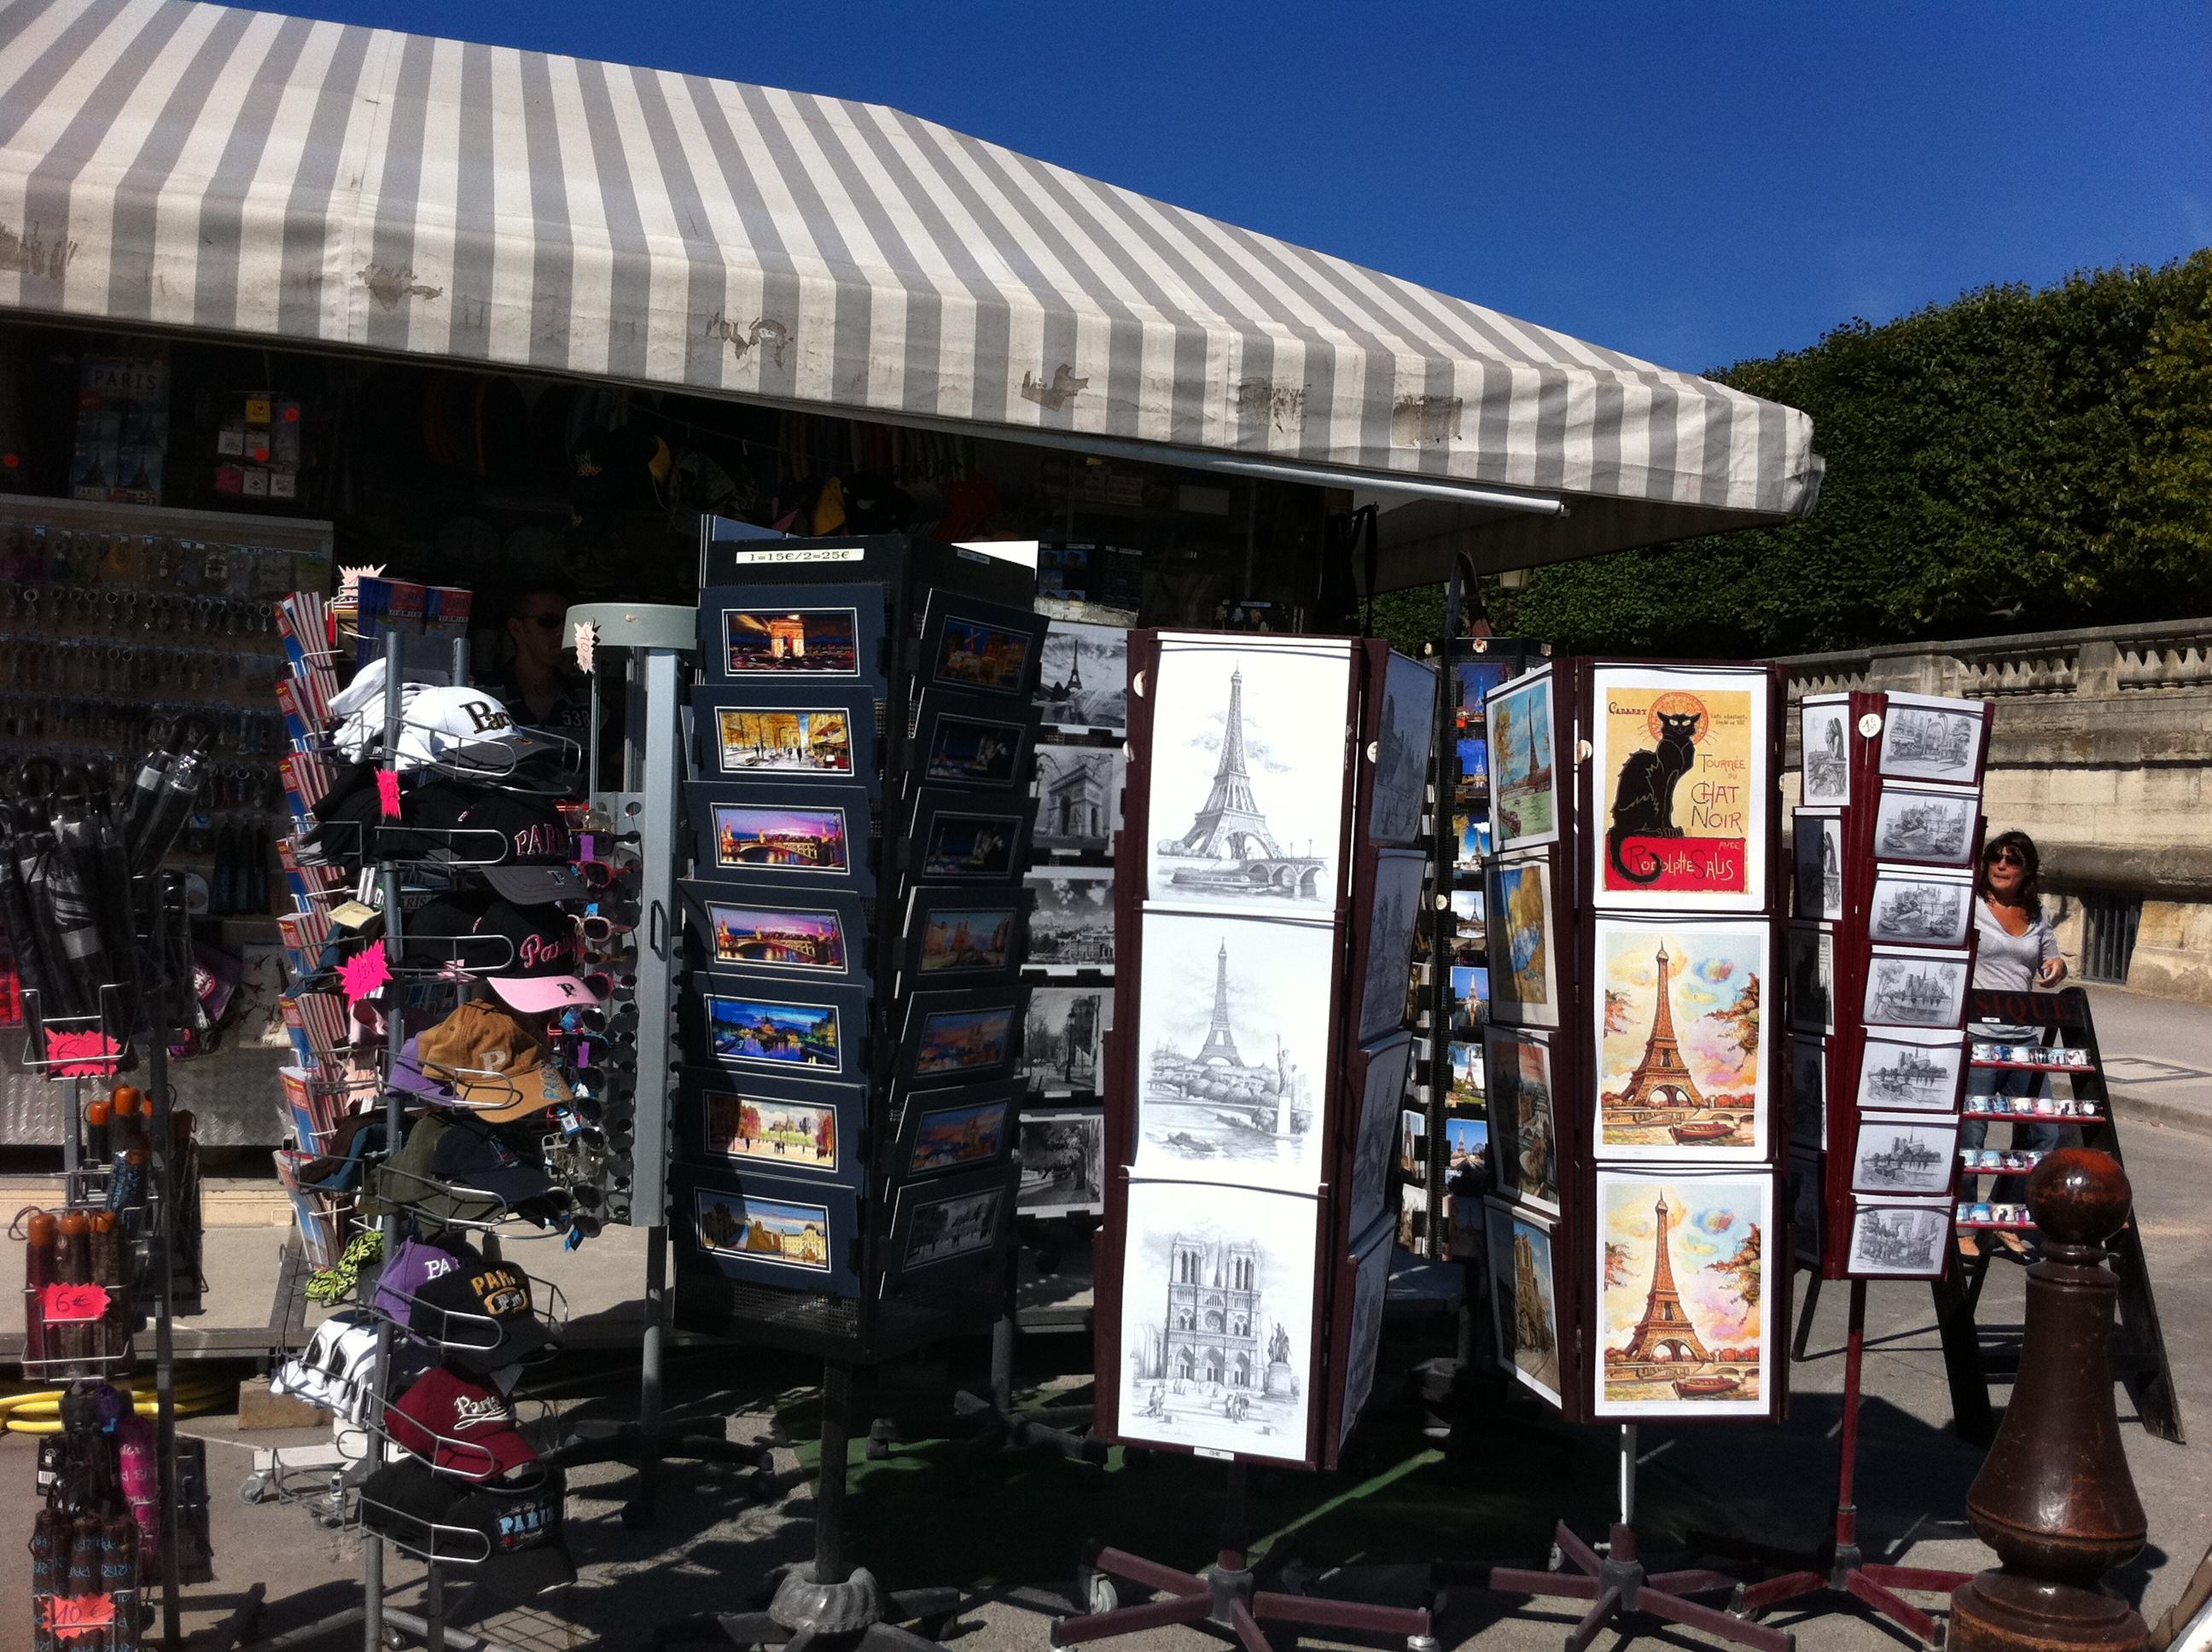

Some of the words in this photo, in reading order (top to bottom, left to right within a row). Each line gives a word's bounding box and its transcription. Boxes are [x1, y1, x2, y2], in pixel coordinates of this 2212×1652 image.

[95, 369, 156, 391] PARIS
[1691, 781, 1740, 809] CHAT
[1691, 806, 1743, 833] NOIR
